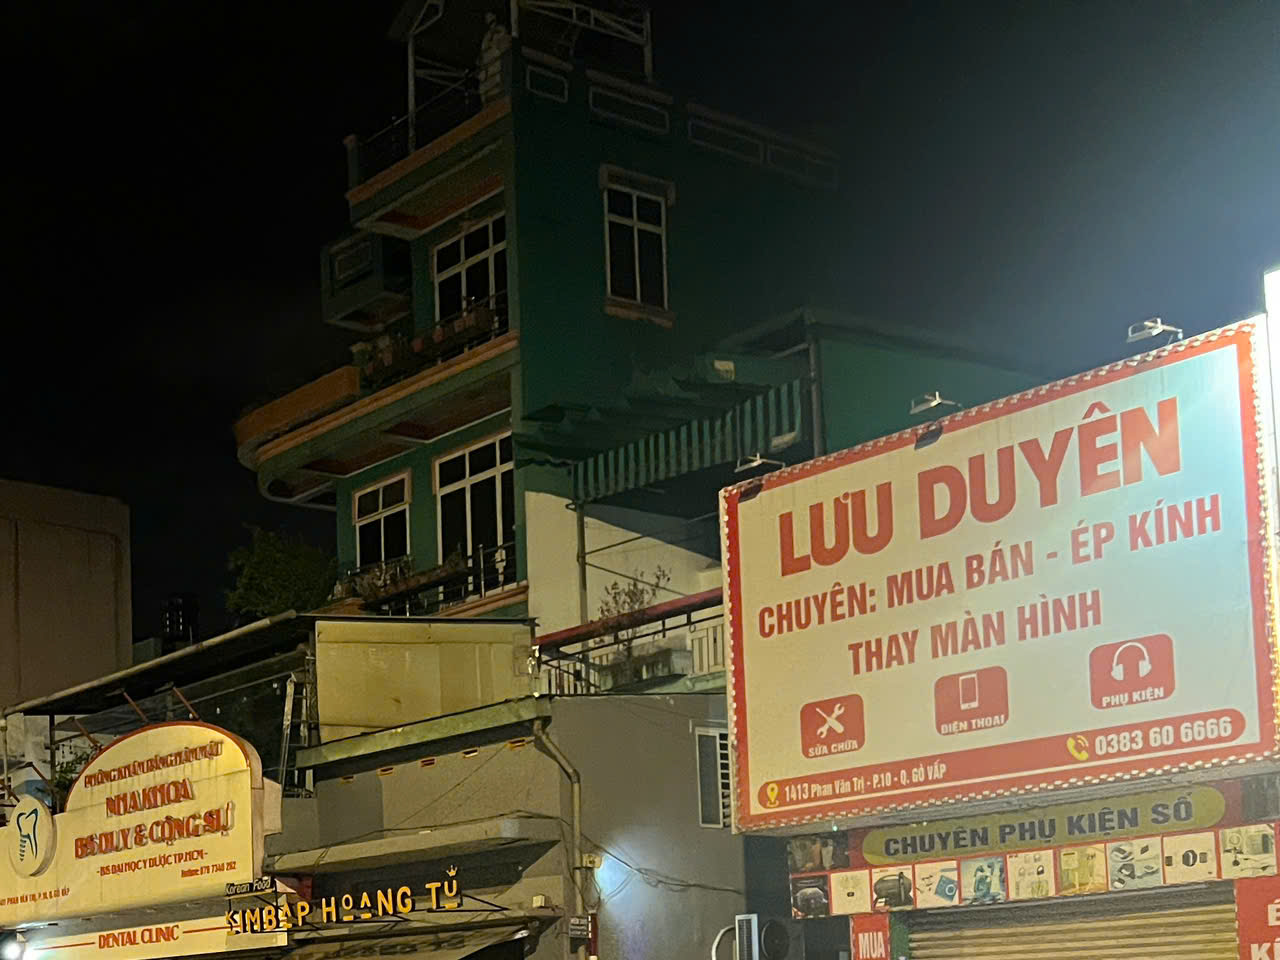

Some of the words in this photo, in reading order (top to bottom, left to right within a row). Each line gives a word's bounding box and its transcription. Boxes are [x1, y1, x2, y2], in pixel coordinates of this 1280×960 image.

[778, 481, 894, 577] LƯU
[918, 396, 1181, 540] DUYÊN
[758, 581, 876, 638] CHUYÊN:
[886, 561, 955, 608] MUA
[965, 539, 1034, 590] BÁN
[1071, 519, 1115, 565] ÉP
[1128, 493, 1221, 551] KÍNH
[847, 628, 920, 676] THAY
[930, 610, 1006, 659] MÀN
[1016, 589, 1102, 641] HÌNH
[1101, 693, 1129, 707] PHỤ
[1132, 686, 1164, 704] KIỆN
[1094, 729, 1144, 756] 0383
[1148, 724, 1175, 748] 60
[1179, 715, 1233, 743] 6666
[784, 782, 809, 802] 1413
[810, 780, 833, 799] Phan
[872, 772, 892, 790] P.10
[884, 827, 989, 856] CHUYÊN
[999, 818, 1057, 843] PHỤ
[1066, 806, 1140, 836] KIỆN
[1150, 792, 1193, 824] SỐ
[225, 883, 250, 895] Korean
[253, 876, 271, 891] Food
[225, 899, 309, 936] KIMBAP
[98, 931, 139, 949] DENTAL
[140, 924, 180, 944] CLINIC
[858, 931, 886, 959] MUA
